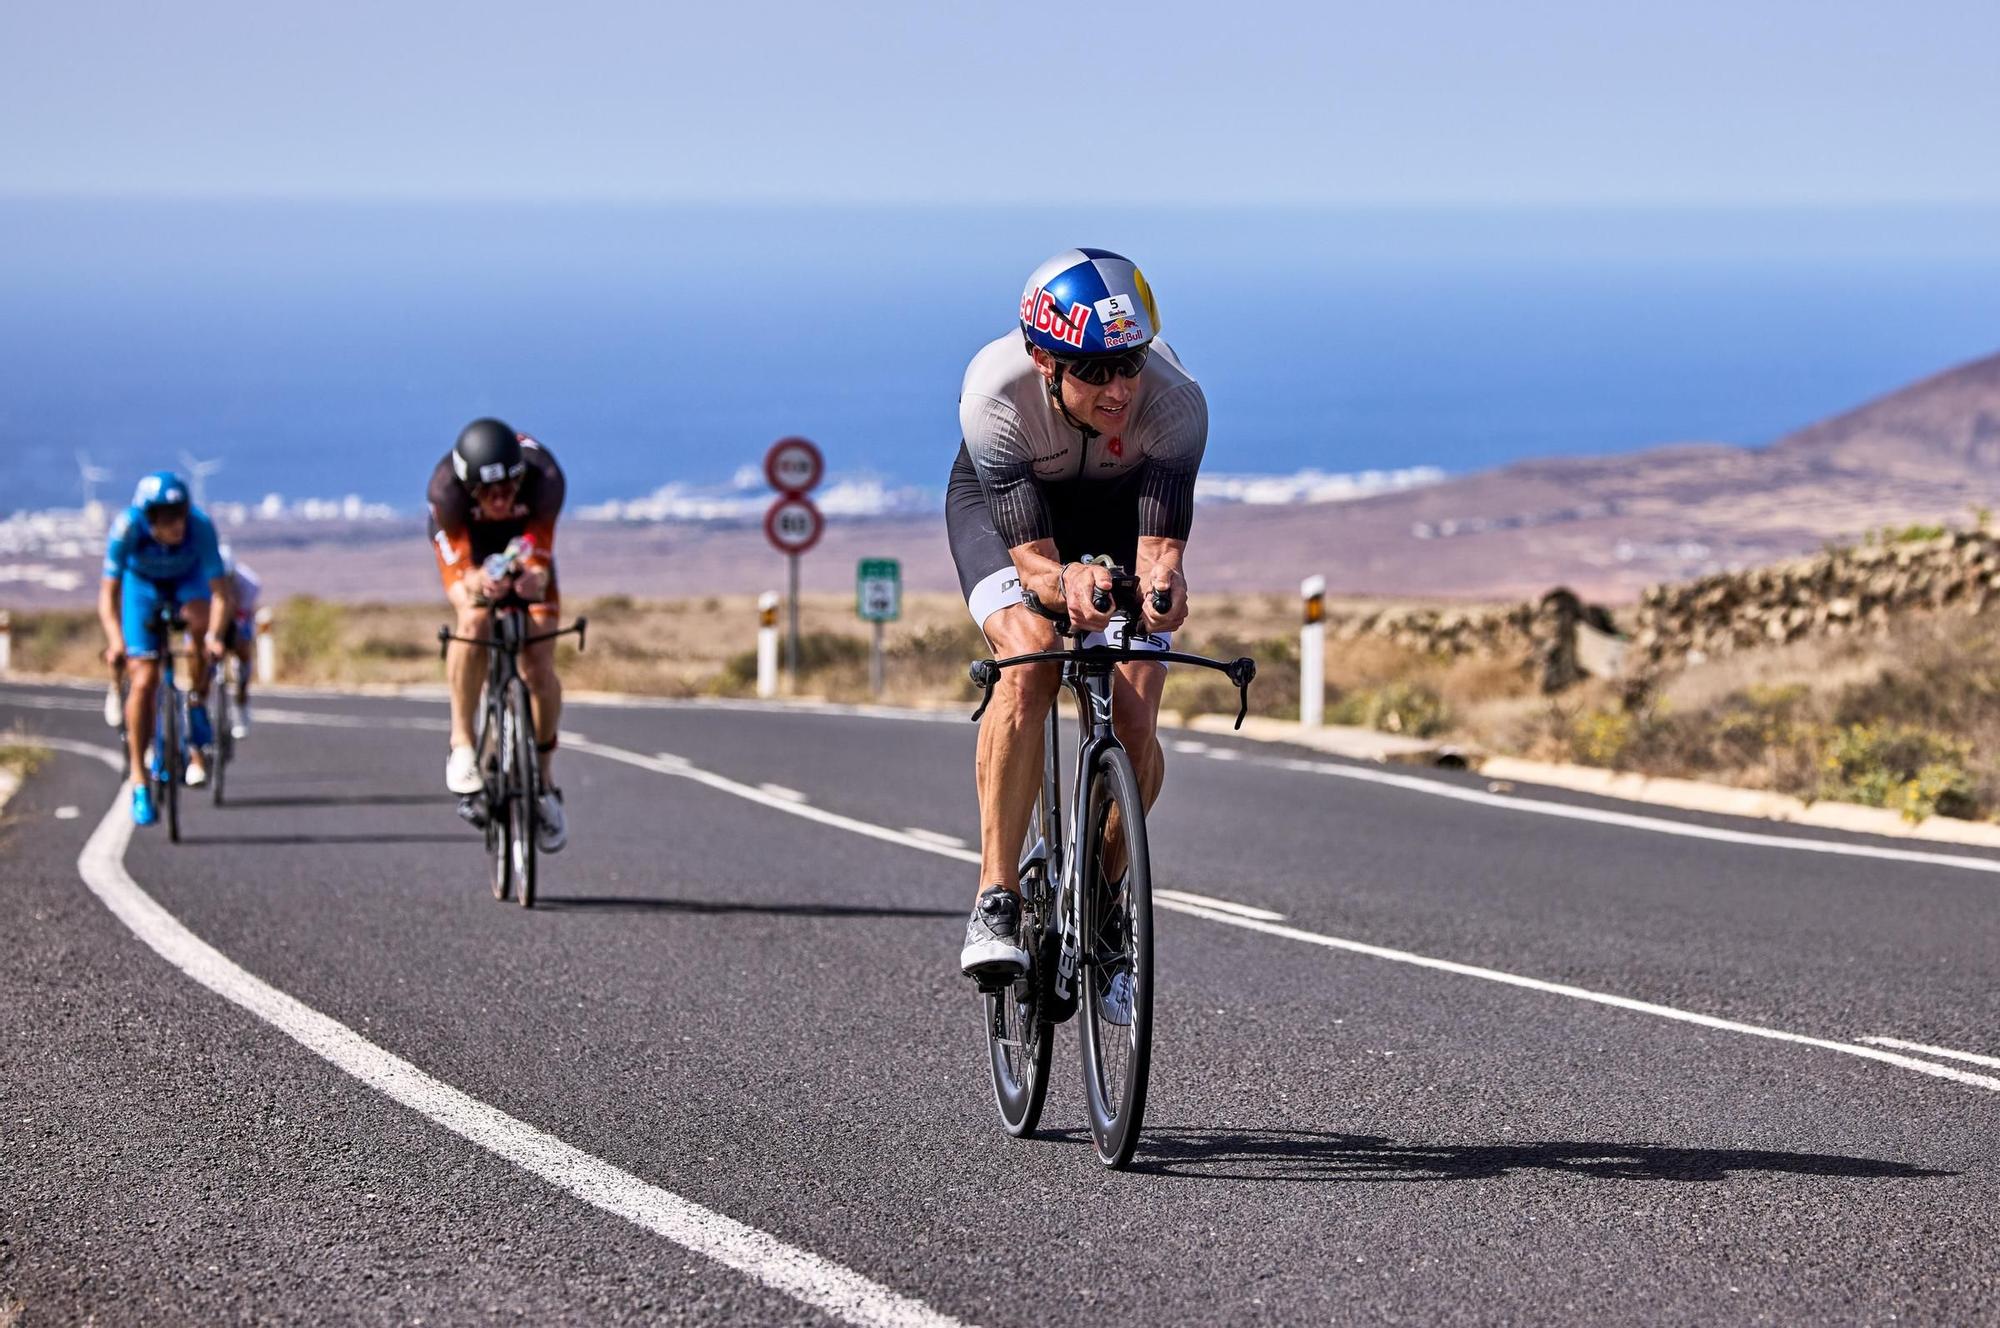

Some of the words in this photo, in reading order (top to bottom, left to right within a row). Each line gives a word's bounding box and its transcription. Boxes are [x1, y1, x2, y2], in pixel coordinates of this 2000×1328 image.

[1035, 292, 1090, 346] Bull
[1109, 299, 1119, 309] 5
[1105, 333, 1125, 347] Red
[1125, 329, 1143, 342] Bull
[1054, 910, 1076, 1001] FELT
